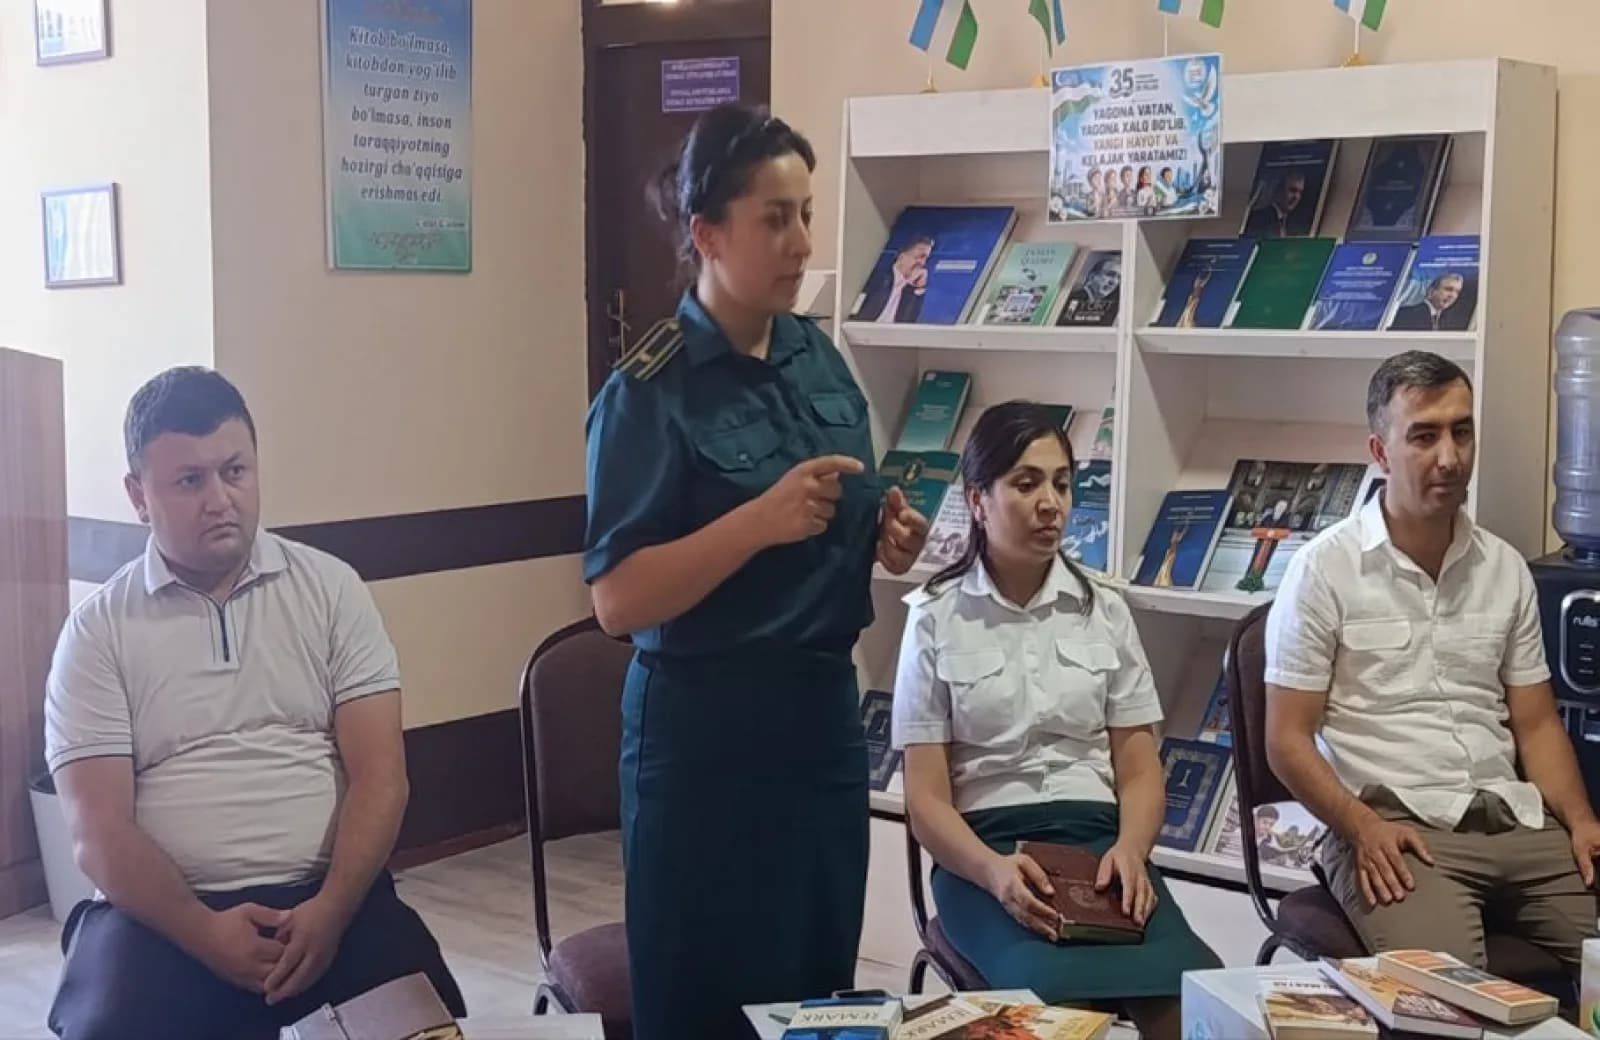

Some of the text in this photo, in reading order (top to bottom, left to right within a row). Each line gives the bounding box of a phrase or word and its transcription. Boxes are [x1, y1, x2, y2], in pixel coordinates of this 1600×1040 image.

[350, 28, 386, 47] Kitob
[1109, 68, 1134, 97] 35
[364, 83, 409, 103] turgan
[417, 112, 452, 129] inson
[1094, 106, 1134, 119] YAGONA
[1081, 123, 1119, 136] YAGONA
[1122, 120, 1149, 133] XALQ
[353, 133, 450, 158] taraqqiyotning
[1126, 135, 1160, 148] HAYOT
[1165, 134, 1178, 146] VA
[341, 156, 389, 178] hozirgi
[361, 185, 418, 202] erishmas
